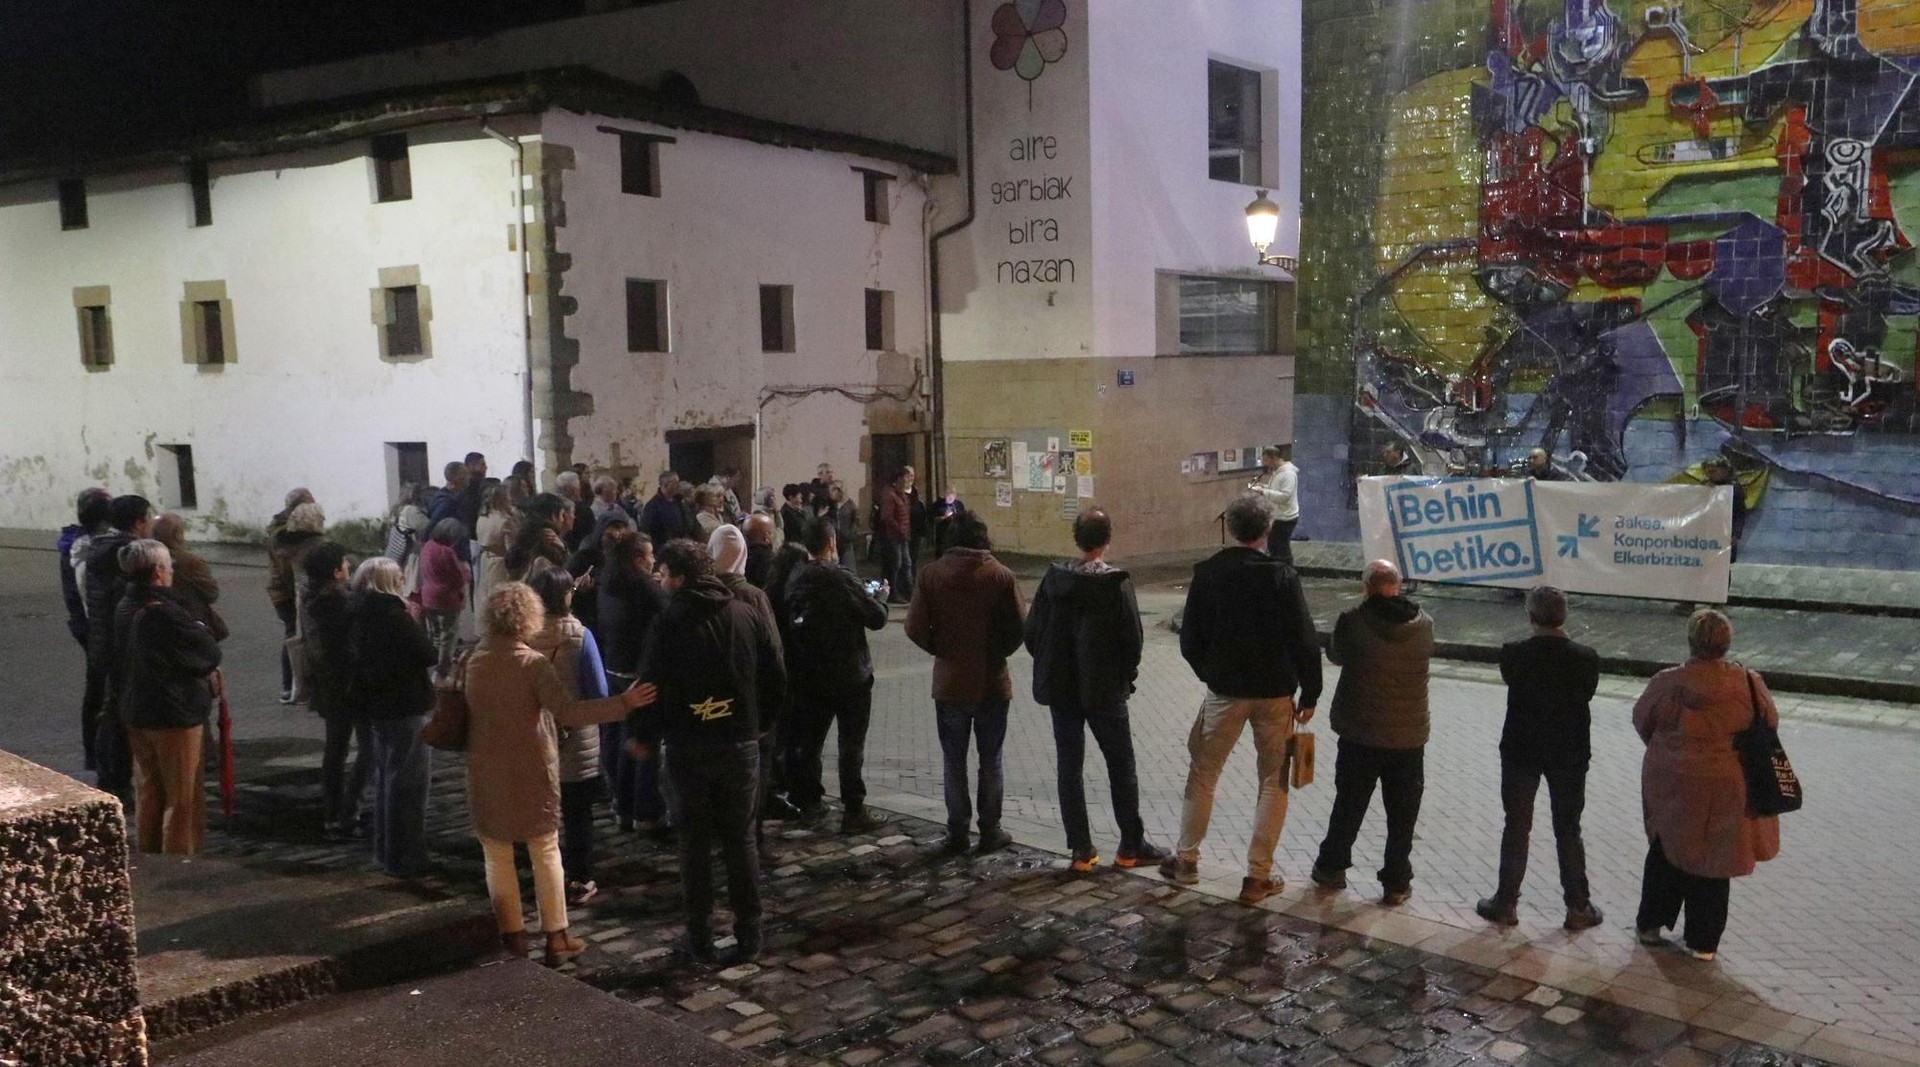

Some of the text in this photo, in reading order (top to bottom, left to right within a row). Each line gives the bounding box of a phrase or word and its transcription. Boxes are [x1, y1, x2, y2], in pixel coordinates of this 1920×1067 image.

[1009, 135, 1058, 162] aire
[991, 174, 1074, 205] garbiak
[1009, 217, 1059, 244] bira
[998, 258, 1075, 284] nazan
[1398, 484, 1502, 527] Behin
[1407, 534, 1532, 575] betiko.
